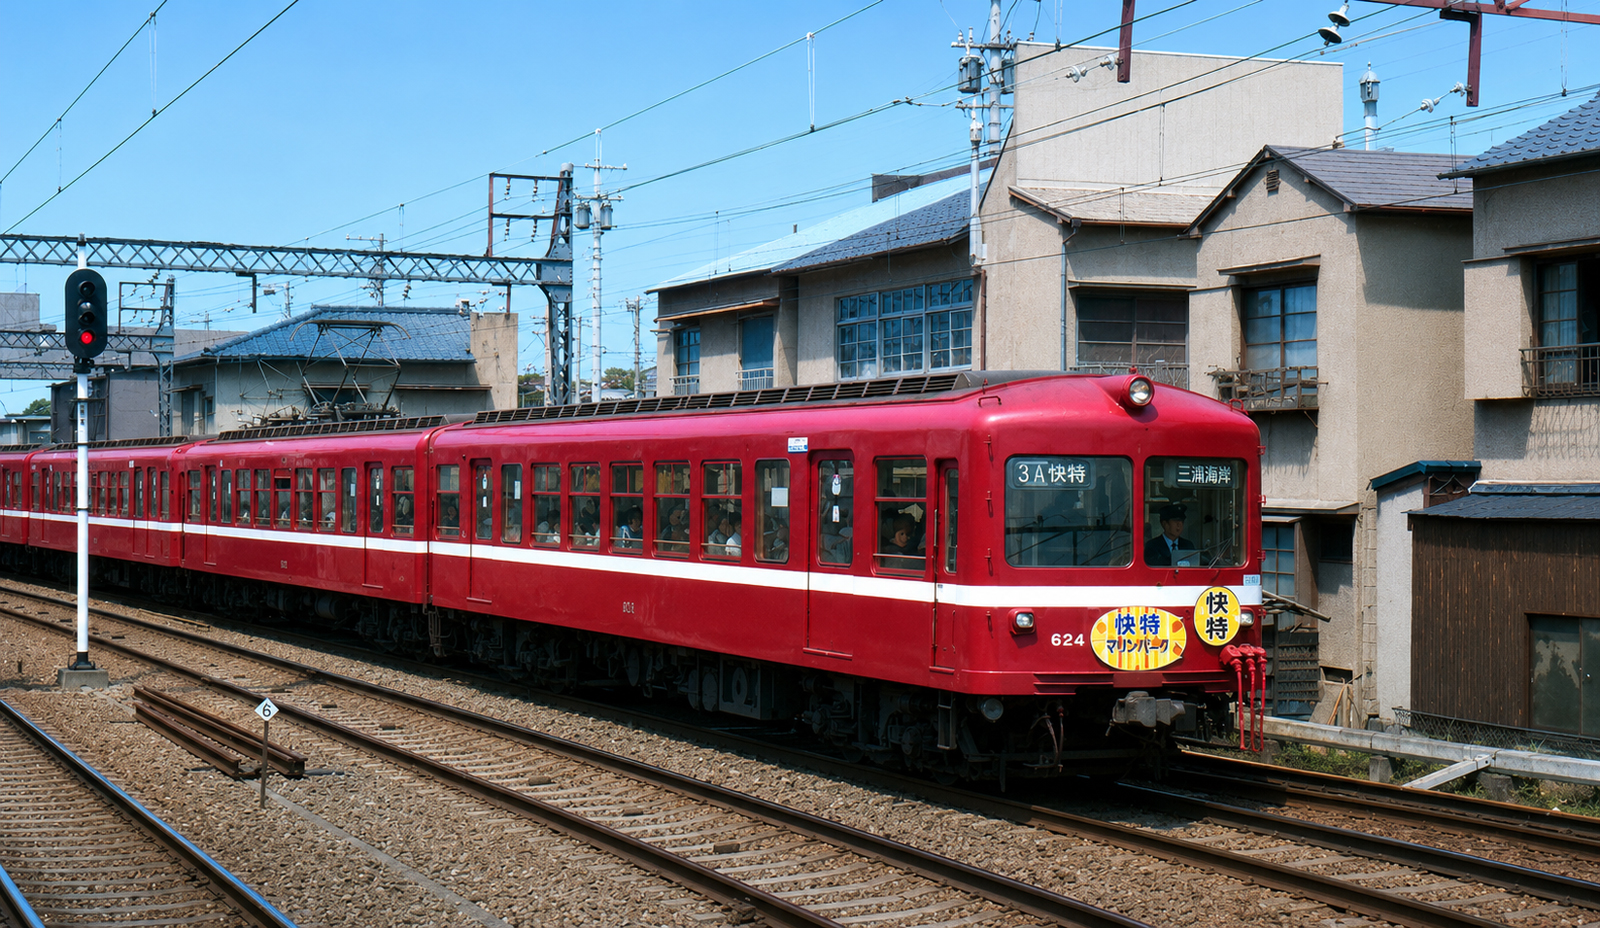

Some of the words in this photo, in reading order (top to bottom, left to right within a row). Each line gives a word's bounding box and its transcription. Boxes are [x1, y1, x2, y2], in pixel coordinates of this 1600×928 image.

[1177, 465, 1232, 484] 三浦海岸
[1115, 613, 1160, 635] 快特
[1205, 591, 1229, 640] 快特
[1051, 633, 1085, 647] 624
[262, 703, 271, 717] 6
